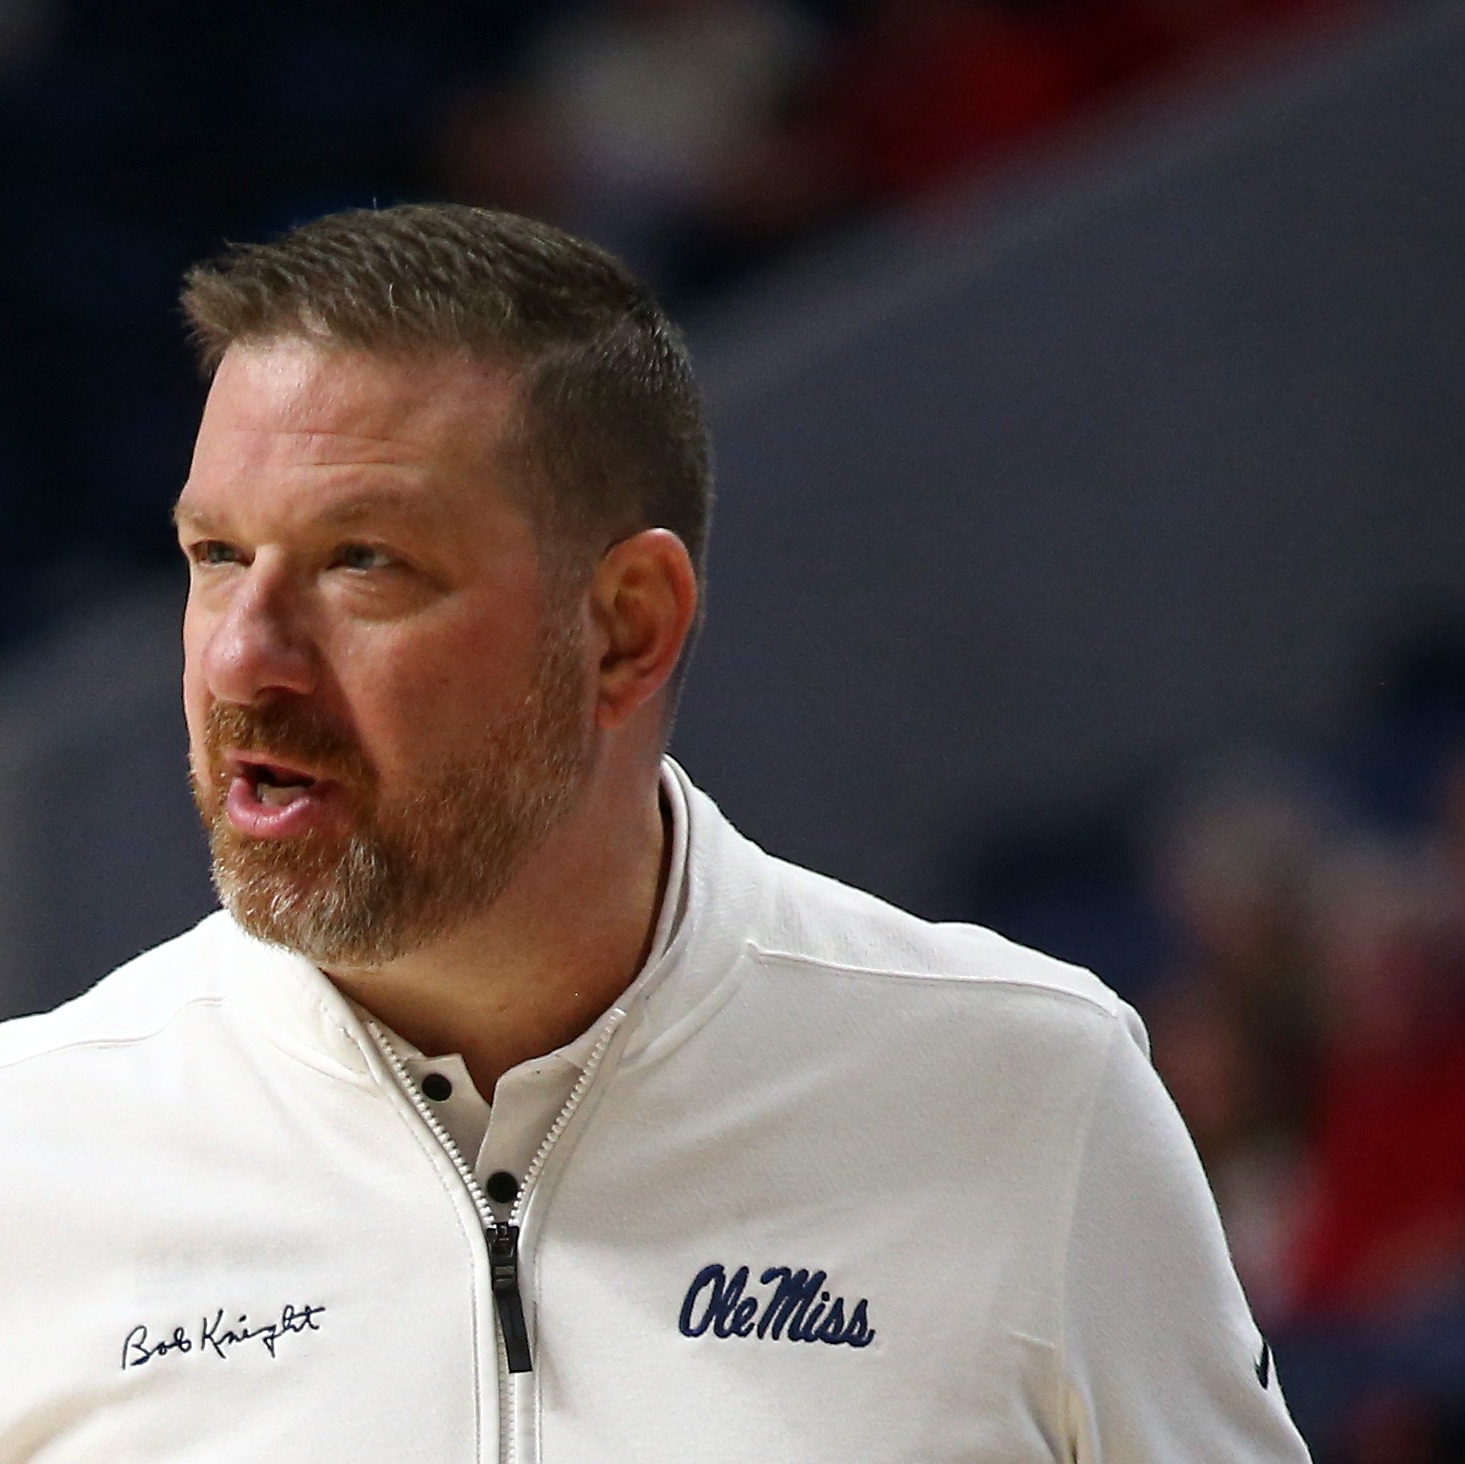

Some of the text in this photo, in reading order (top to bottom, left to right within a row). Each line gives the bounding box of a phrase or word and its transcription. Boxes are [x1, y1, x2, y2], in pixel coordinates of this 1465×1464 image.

[122, 1304, 326, 1371] Bob Knight
[679, 1263, 876, 1348] Ole Miss
